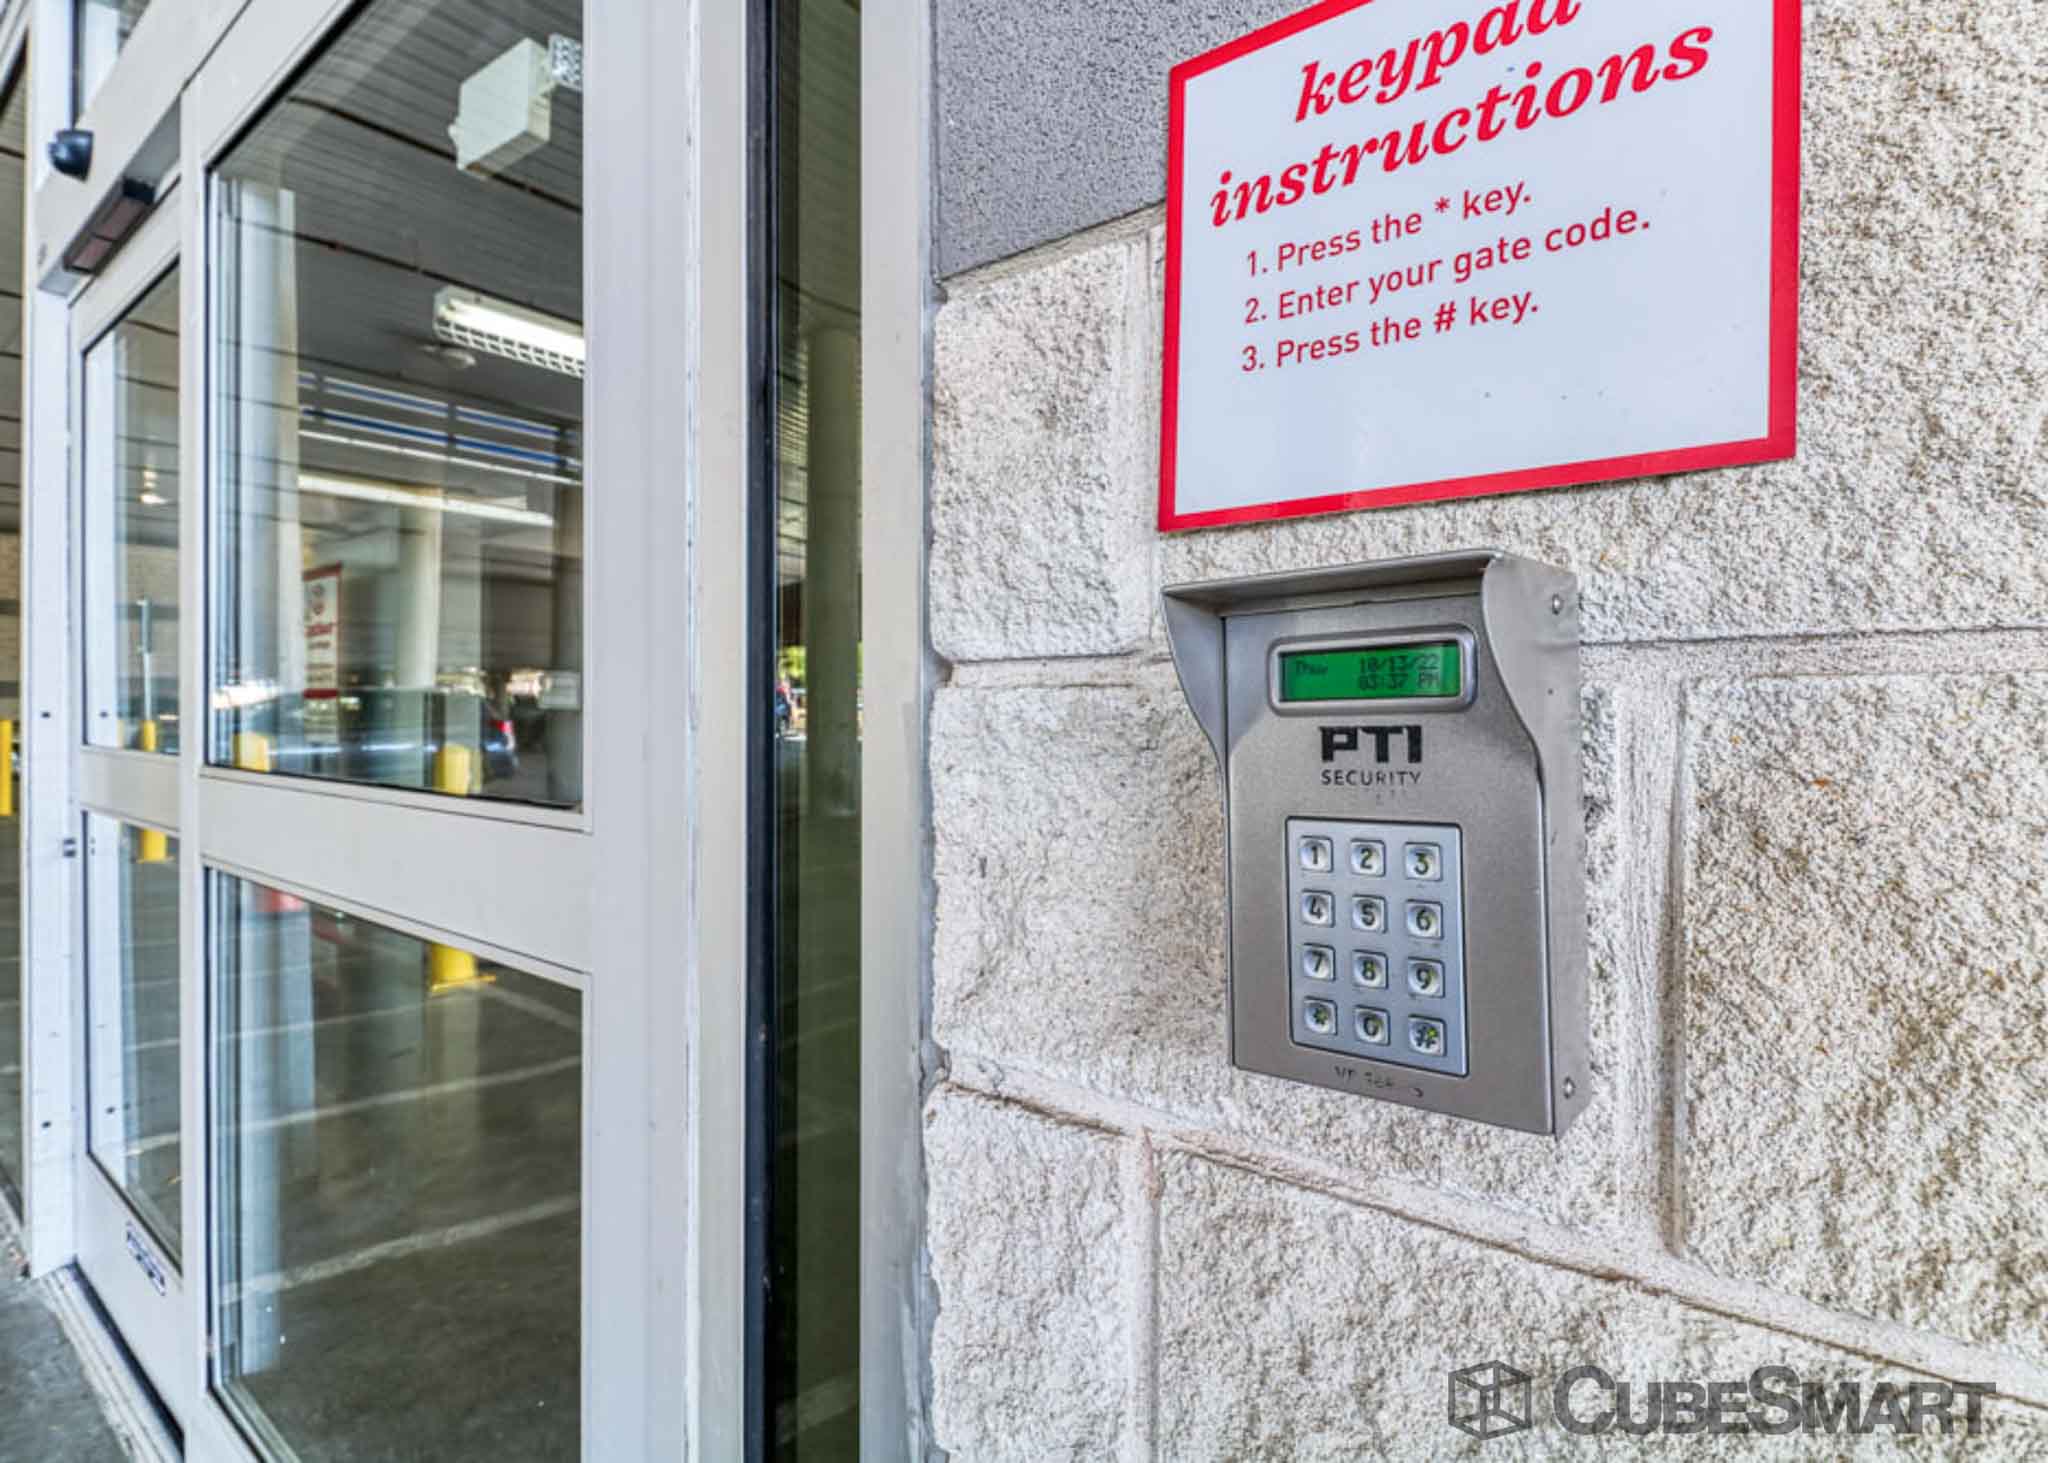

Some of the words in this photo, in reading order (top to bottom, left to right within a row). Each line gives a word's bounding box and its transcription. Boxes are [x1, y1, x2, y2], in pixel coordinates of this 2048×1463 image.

[1211, 26, 1714, 228] instructions
[1247, 251, 1268, 276] 1.
[1277, 230, 1361, 272] Press
[1371, 212, 1423, 245] the
[1462, 181, 1532, 220] key.
[1245, 297, 1267, 325] 2.
[1278, 281, 1360, 321] Enter
[1368, 259, 1442, 305] your
[1453, 237, 1532, 284] gate
[1544, 207, 1650, 253] code.
[1242, 345, 1265, 373] 3.
[1276, 331, 1361, 369] Press
[1370, 318, 1422, 348] the
[1434, 302, 1457, 334] #
[1469, 291, 1538, 326] key.
[1321, 725, 1422, 763] PTI
[1321, 769, 1422, 786] SECURITY
[1360, 848, 1373, 870] 2
[1414, 853, 1429, 875] 3
[1309, 898, 1322, 919] 4
[1361, 903, 1376, 926] 5
[1416, 909, 1432, 932] 6
[1311, 951, 1324, 973] 7
[1362, 960, 1376, 981] 8
[1417, 966, 1433, 989] 9
[1363, 1015, 1379, 1037] 0
